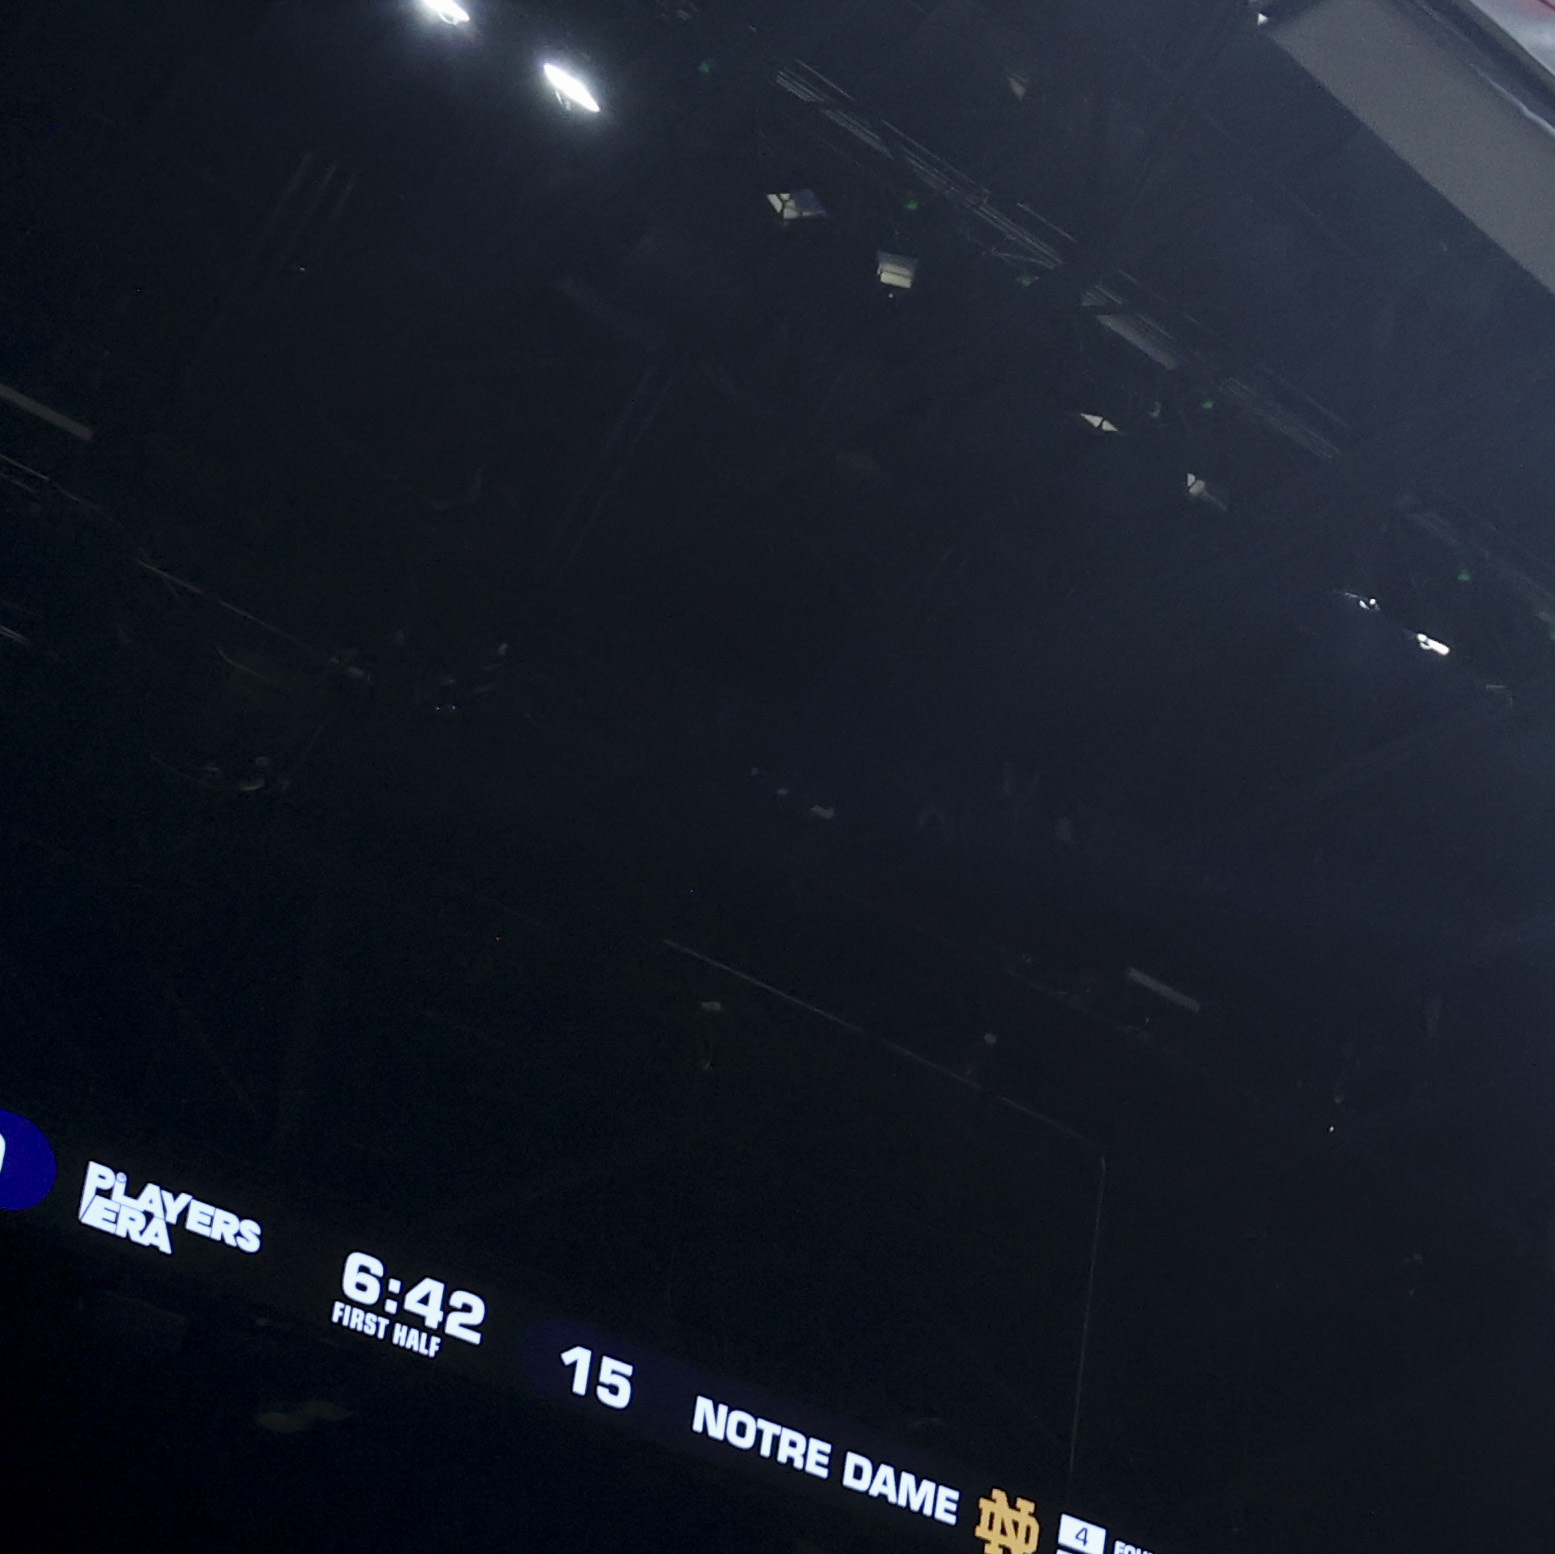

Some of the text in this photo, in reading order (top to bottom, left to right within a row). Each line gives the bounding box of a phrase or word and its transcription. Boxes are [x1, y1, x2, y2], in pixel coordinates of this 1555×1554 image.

[80, 1161, 262, 1253] PLAYERS
[80, 1195, 172, 1254] ERA
[331, 1300, 442, 1358] FIRST HALF
[342, 1251, 487, 1345] 6:42
[560, 1345, 634, 1410] 15
[692, 1395, 961, 1527] NOTRE DAME
[1074, 1526, 1090, 1547] 4
